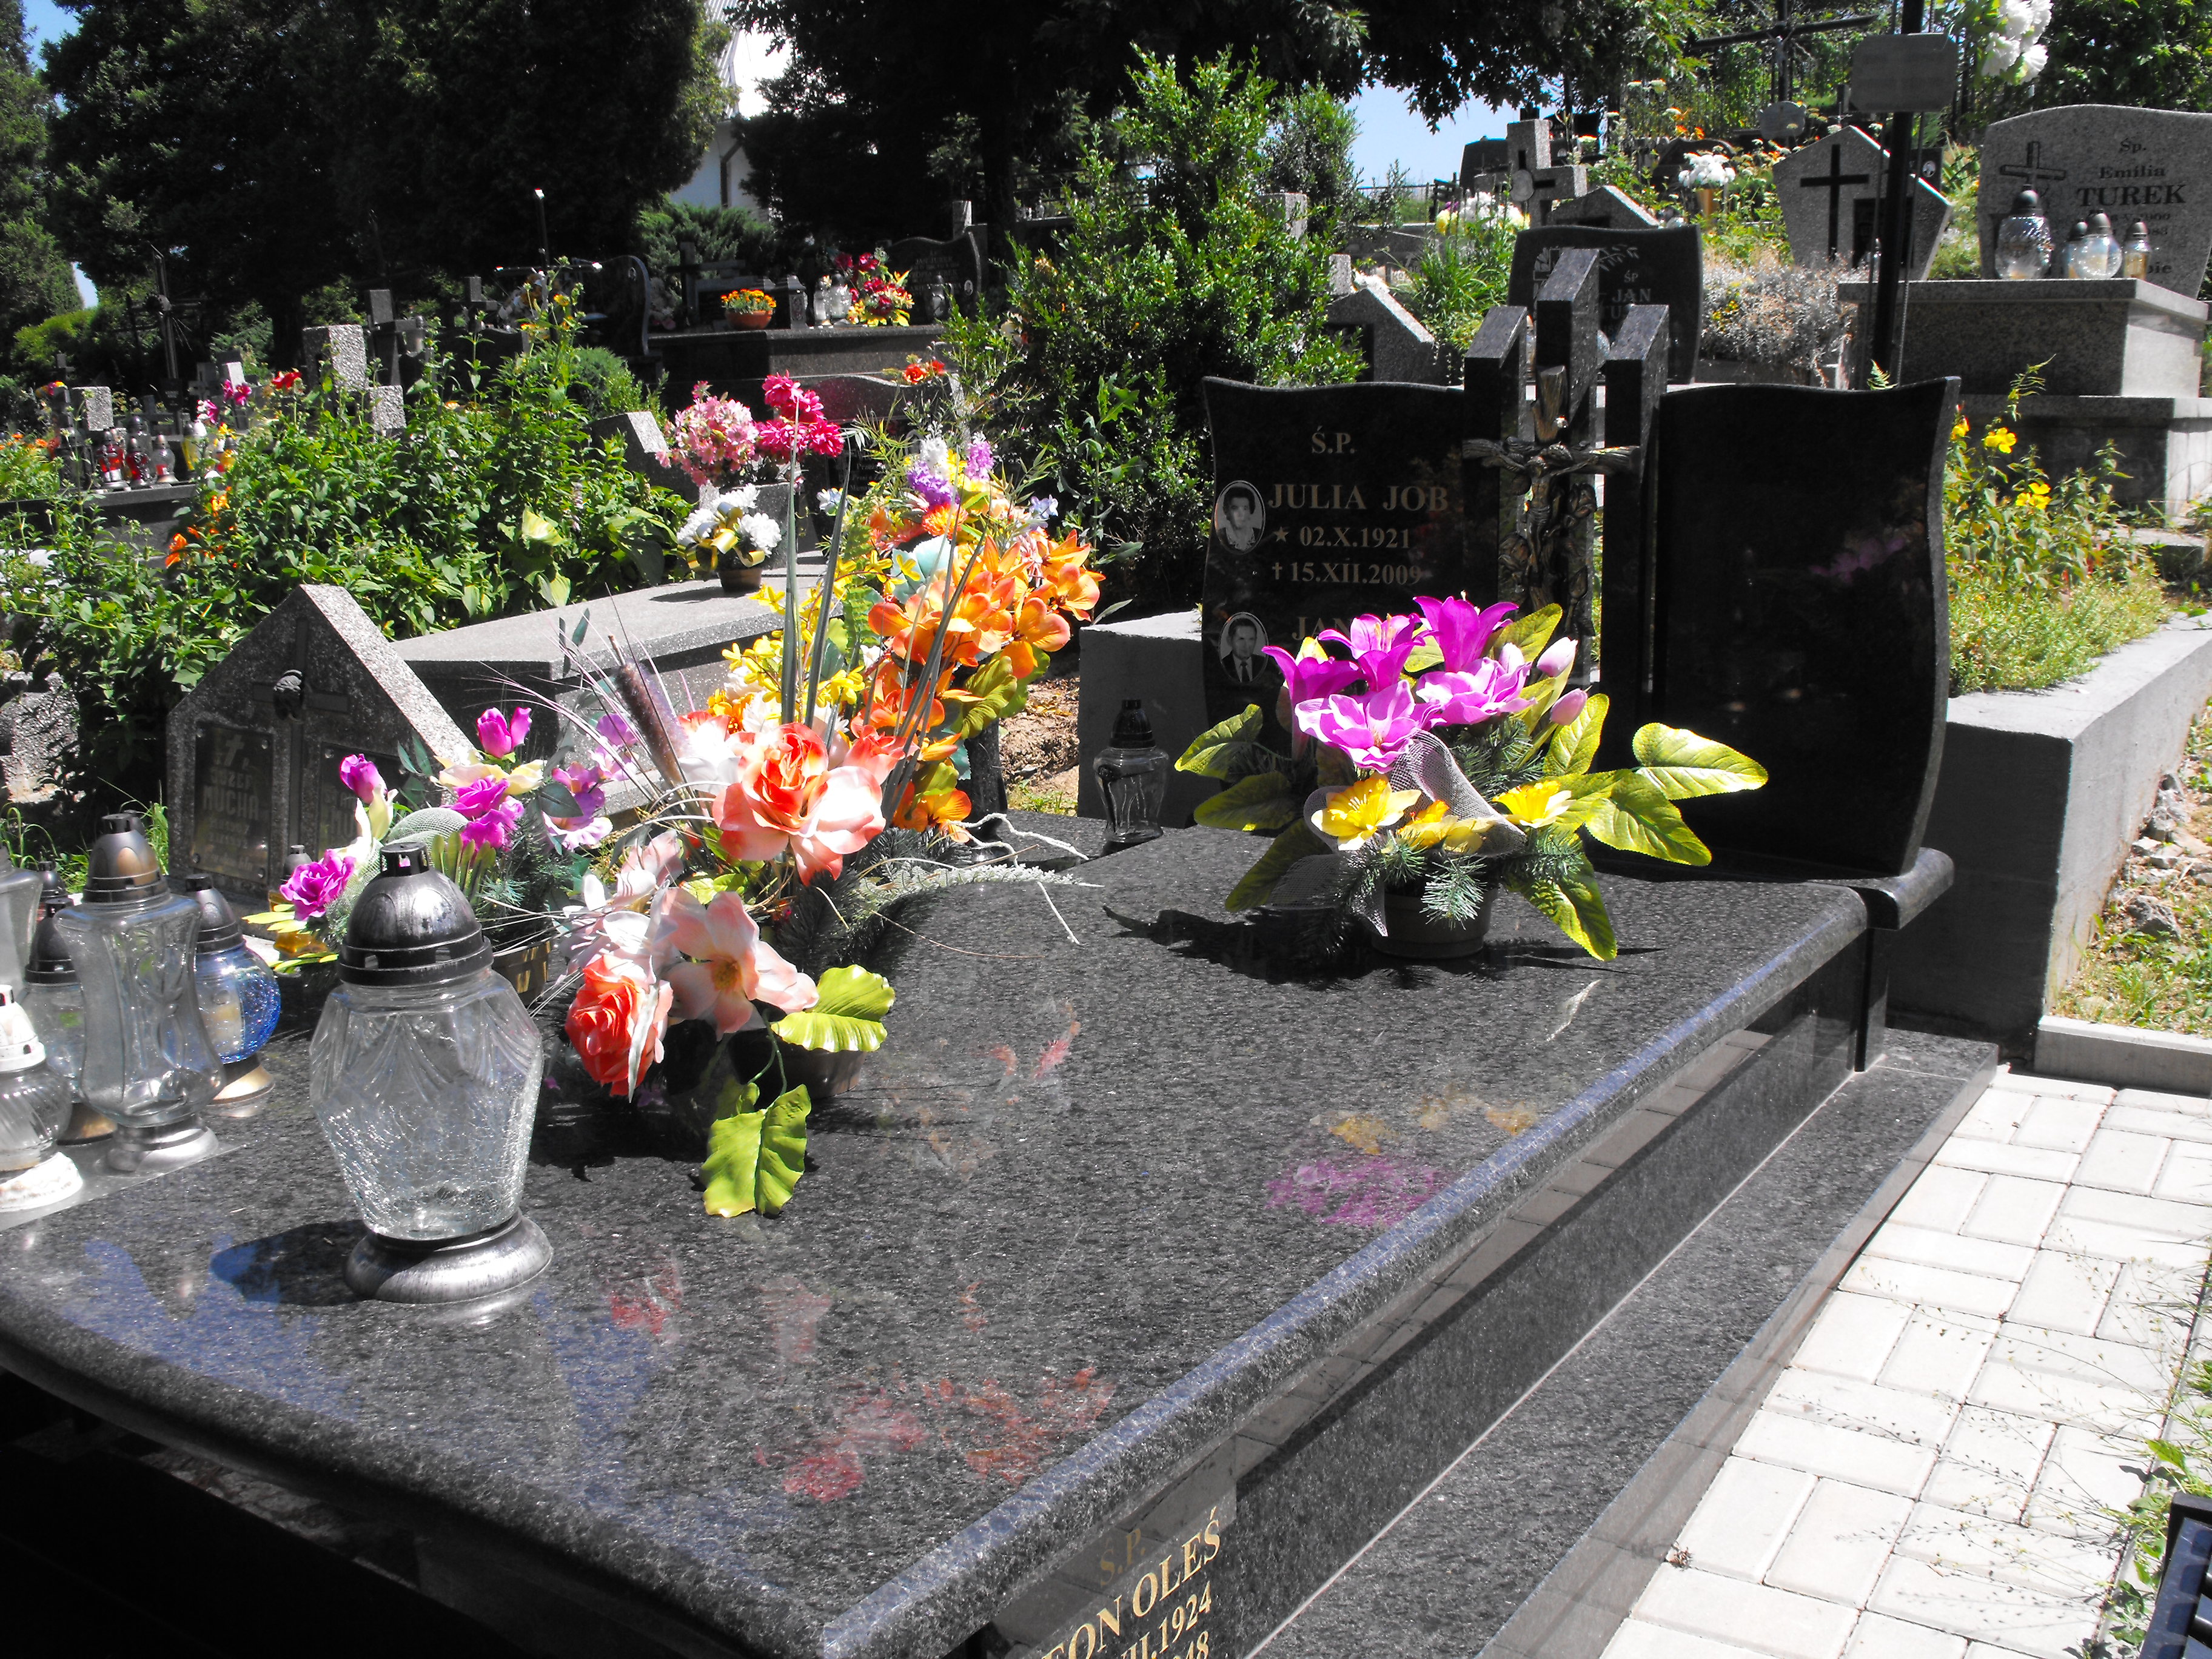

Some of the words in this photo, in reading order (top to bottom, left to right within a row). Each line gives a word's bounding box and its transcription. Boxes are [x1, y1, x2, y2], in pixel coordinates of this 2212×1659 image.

[2100, 166, 2165, 179] Emilia
[2078, 185, 2185, 207] TUREK
[1611, 288, 1652, 303] JAN
[1311, 424, 1356, 455] Ś.P.
[1267, 483, 1367, 511] JULIA
[1382, 486, 1449, 512] JOB
[1299, 526, 1410, 549] 02.X.1921
[1290, 561, 1423, 586] 15.XII.2009
[203, 785, 260, 820] MUCHA
[1131, 1506, 1221, 1617] OLEŚ
